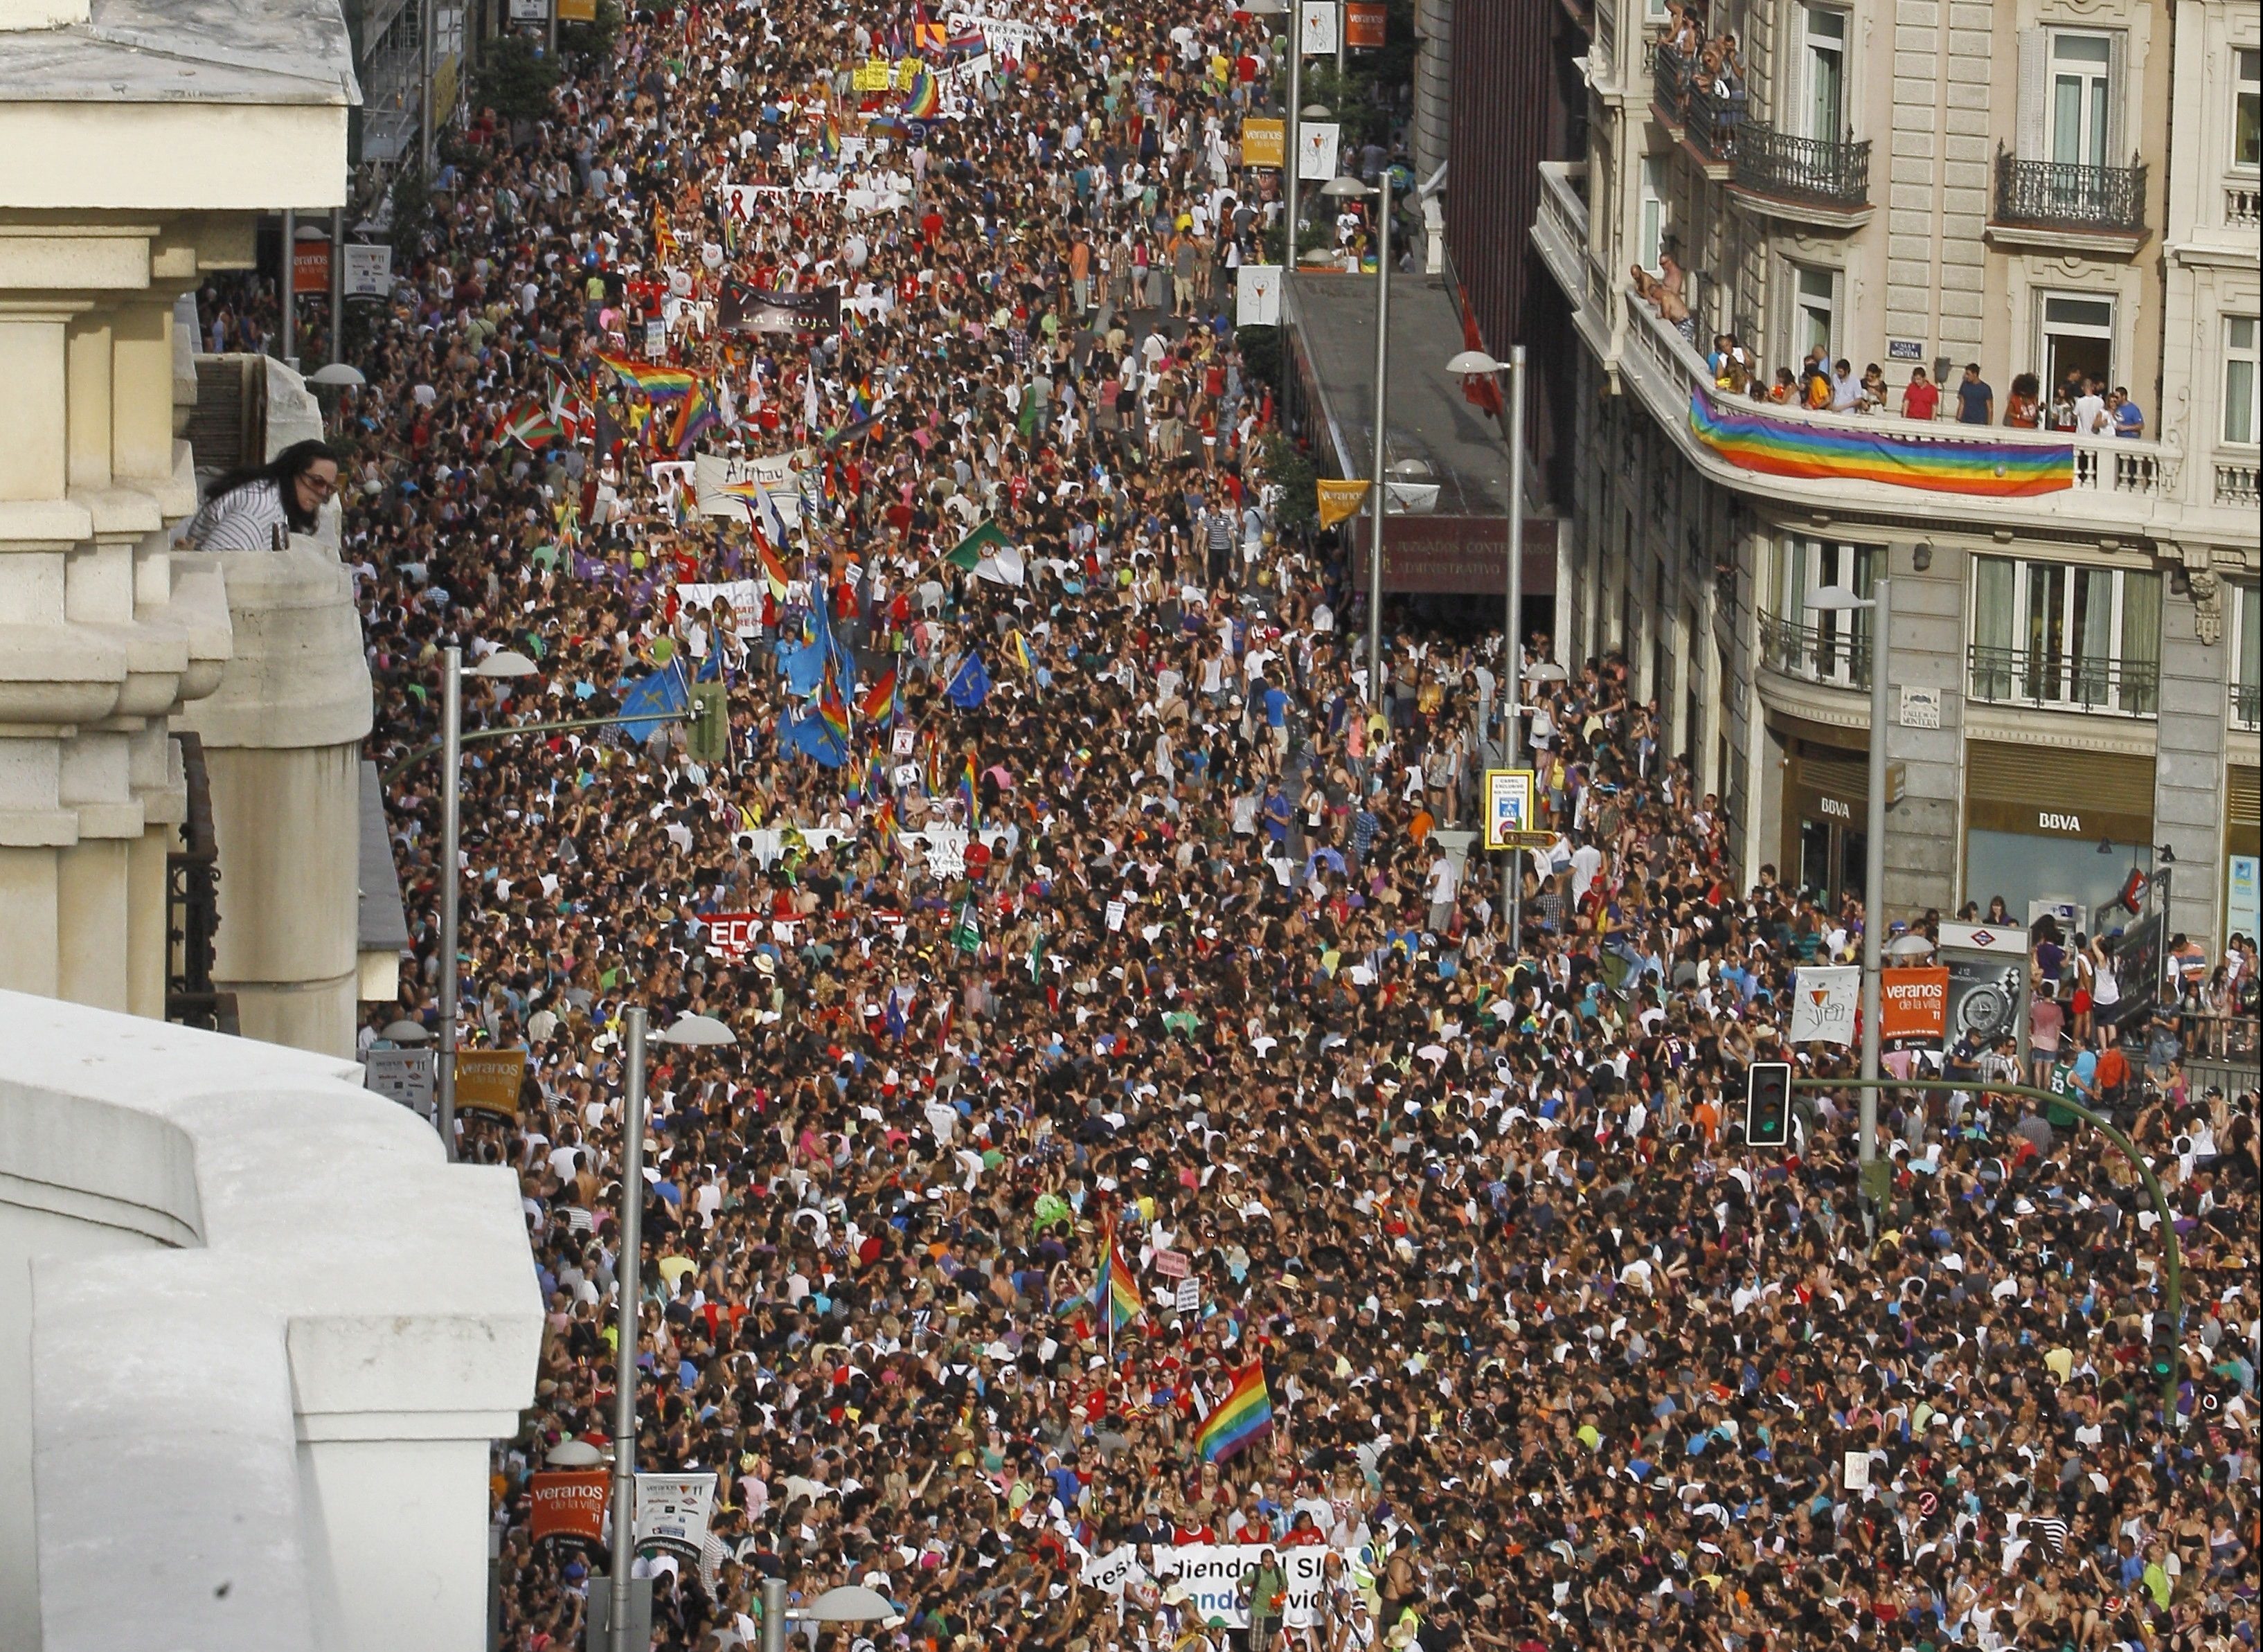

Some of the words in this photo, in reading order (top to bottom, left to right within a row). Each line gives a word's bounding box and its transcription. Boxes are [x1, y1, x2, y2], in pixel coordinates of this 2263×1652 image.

[294, 255, 328, 266] eranos
[741, 312, 764, 324] LA
[1396, 541, 1460, 554] JUZGADOS
[1466, 542, 1554, 555] CONTEIOSO
[1397, 562, 1501, 575] ADMINISTRATIVO
[1903, 717, 1938, 728] MONTERA
[1821, 797, 1850, 819] BBVA
[2039, 812, 2081, 832] BBVA
[1886, 984, 1943, 998] veranos
[1899, 998, 1912, 1010] de
[1913, 998, 1922, 1009] la
[1923, 998, 1941, 1010] villa
[1932, 1010, 1941, 1021] 11
[462, 1063, 518, 1077] veranos
[535, 1484, 604, 1501] veranos
[693, 1485, 703, 1496] 11
[551, 1497, 566, 1510] de
[568, 1497, 578, 1509] la
[580, 1498, 601, 1514] villa
[592, 1511, 600, 1525] 11
